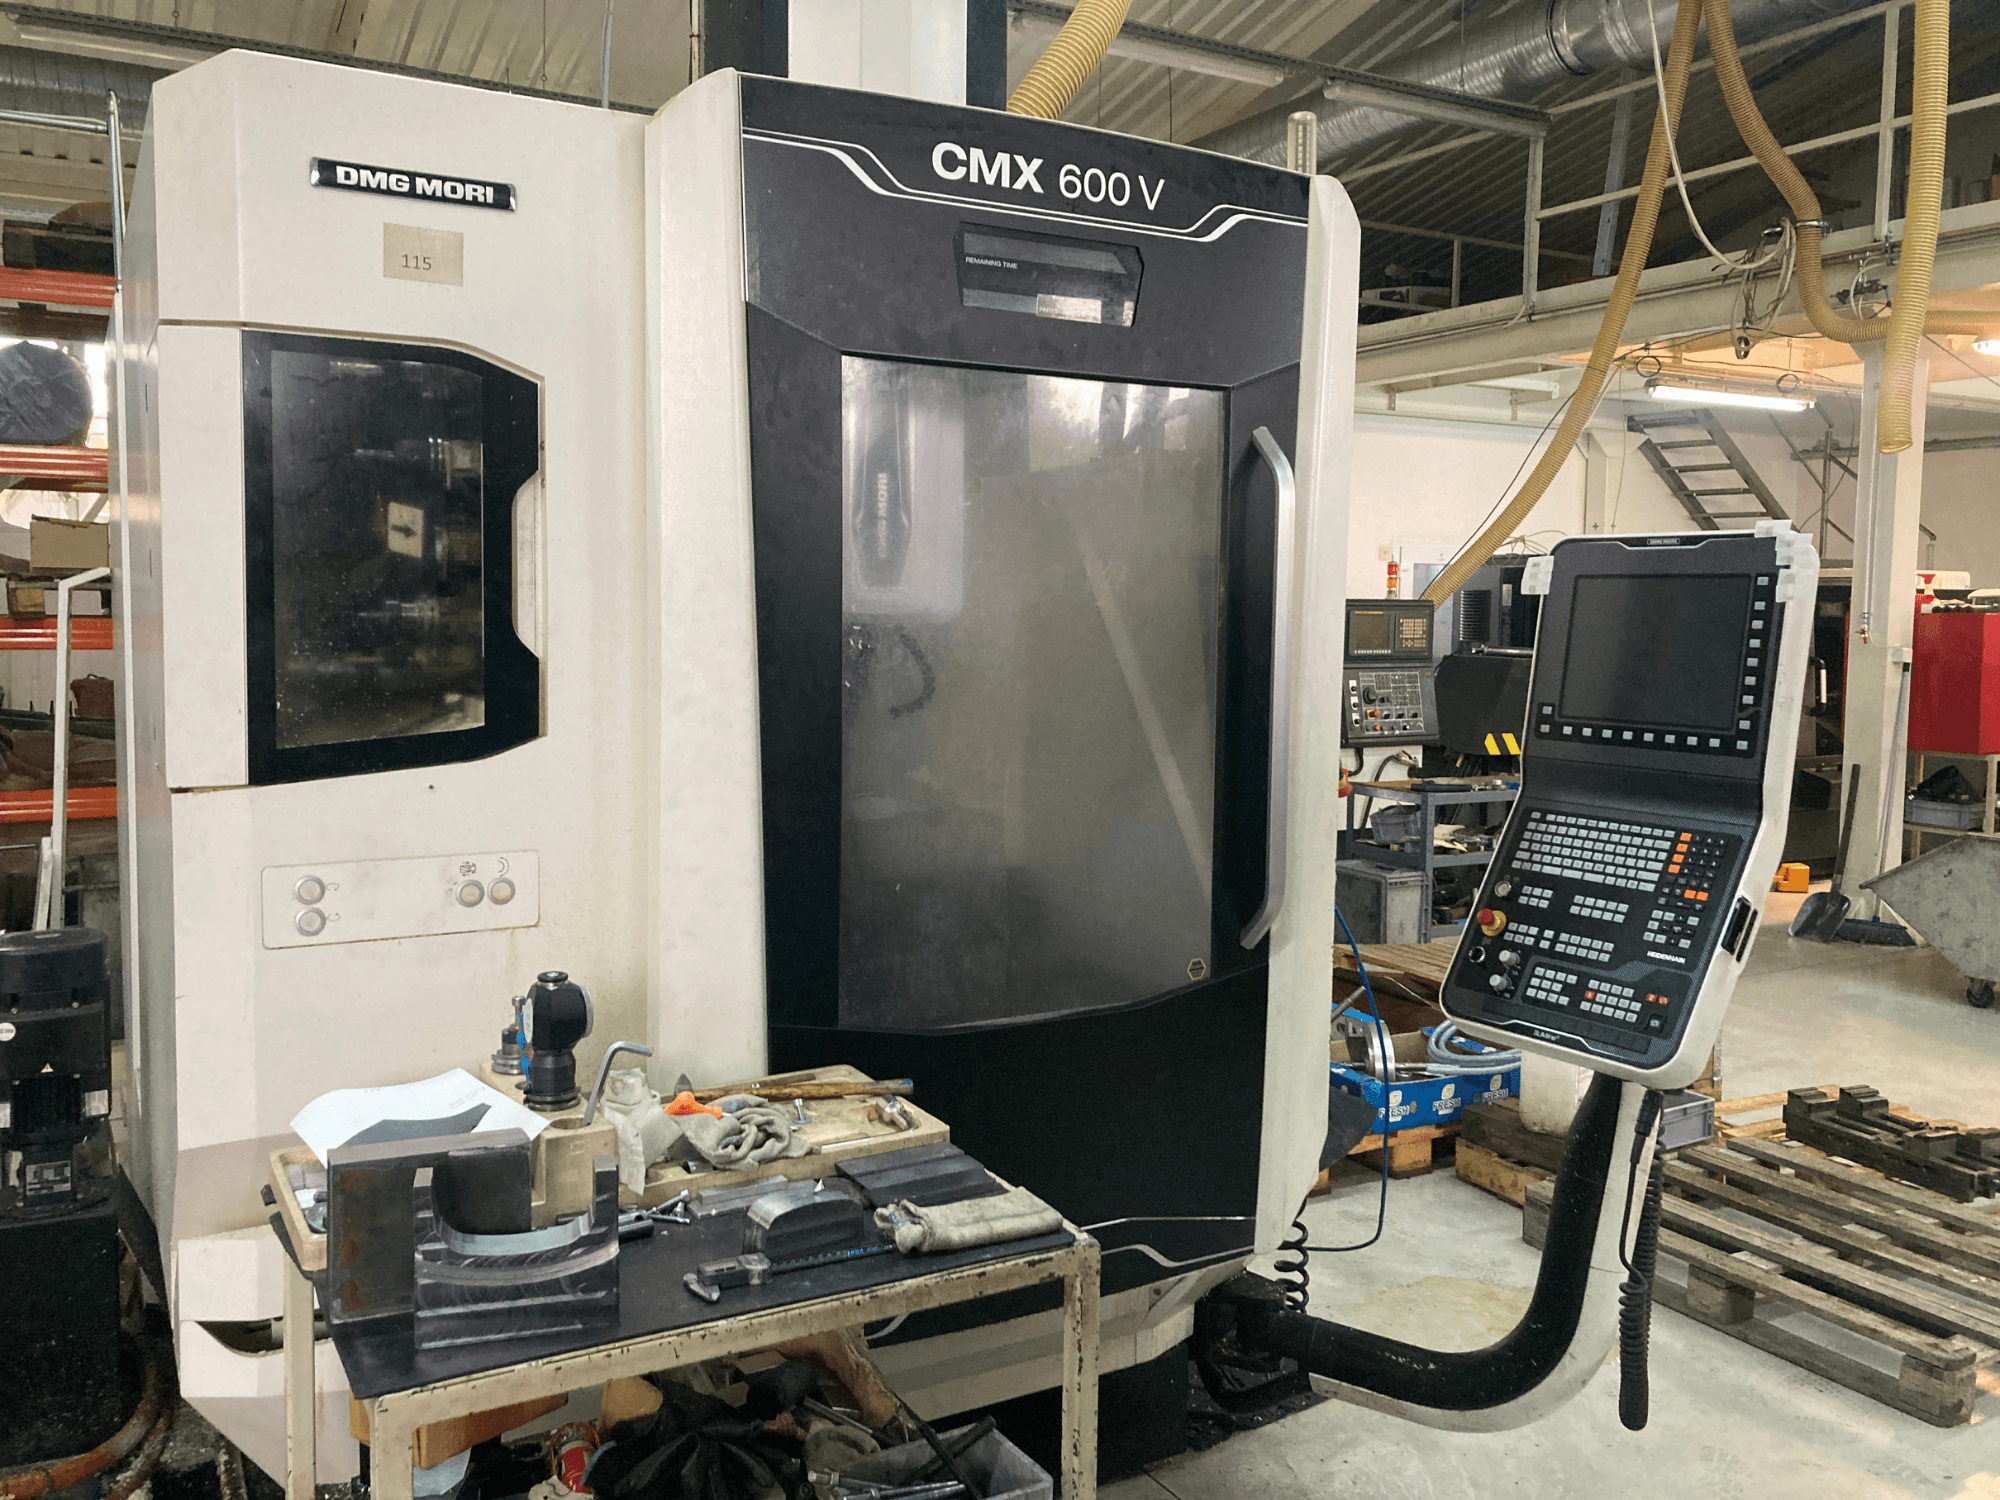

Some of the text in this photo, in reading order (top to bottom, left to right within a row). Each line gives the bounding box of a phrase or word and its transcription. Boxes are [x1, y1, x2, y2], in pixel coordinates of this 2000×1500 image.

[336, 165, 494, 204] DMG MORI
[932, 142, 1166, 211] CMX 600 V
[401, 254, 432, 271] 115
[965, 256, 1018, 270] REMAINING TIME
[1432, 1097, 1461, 1111] FRESH
